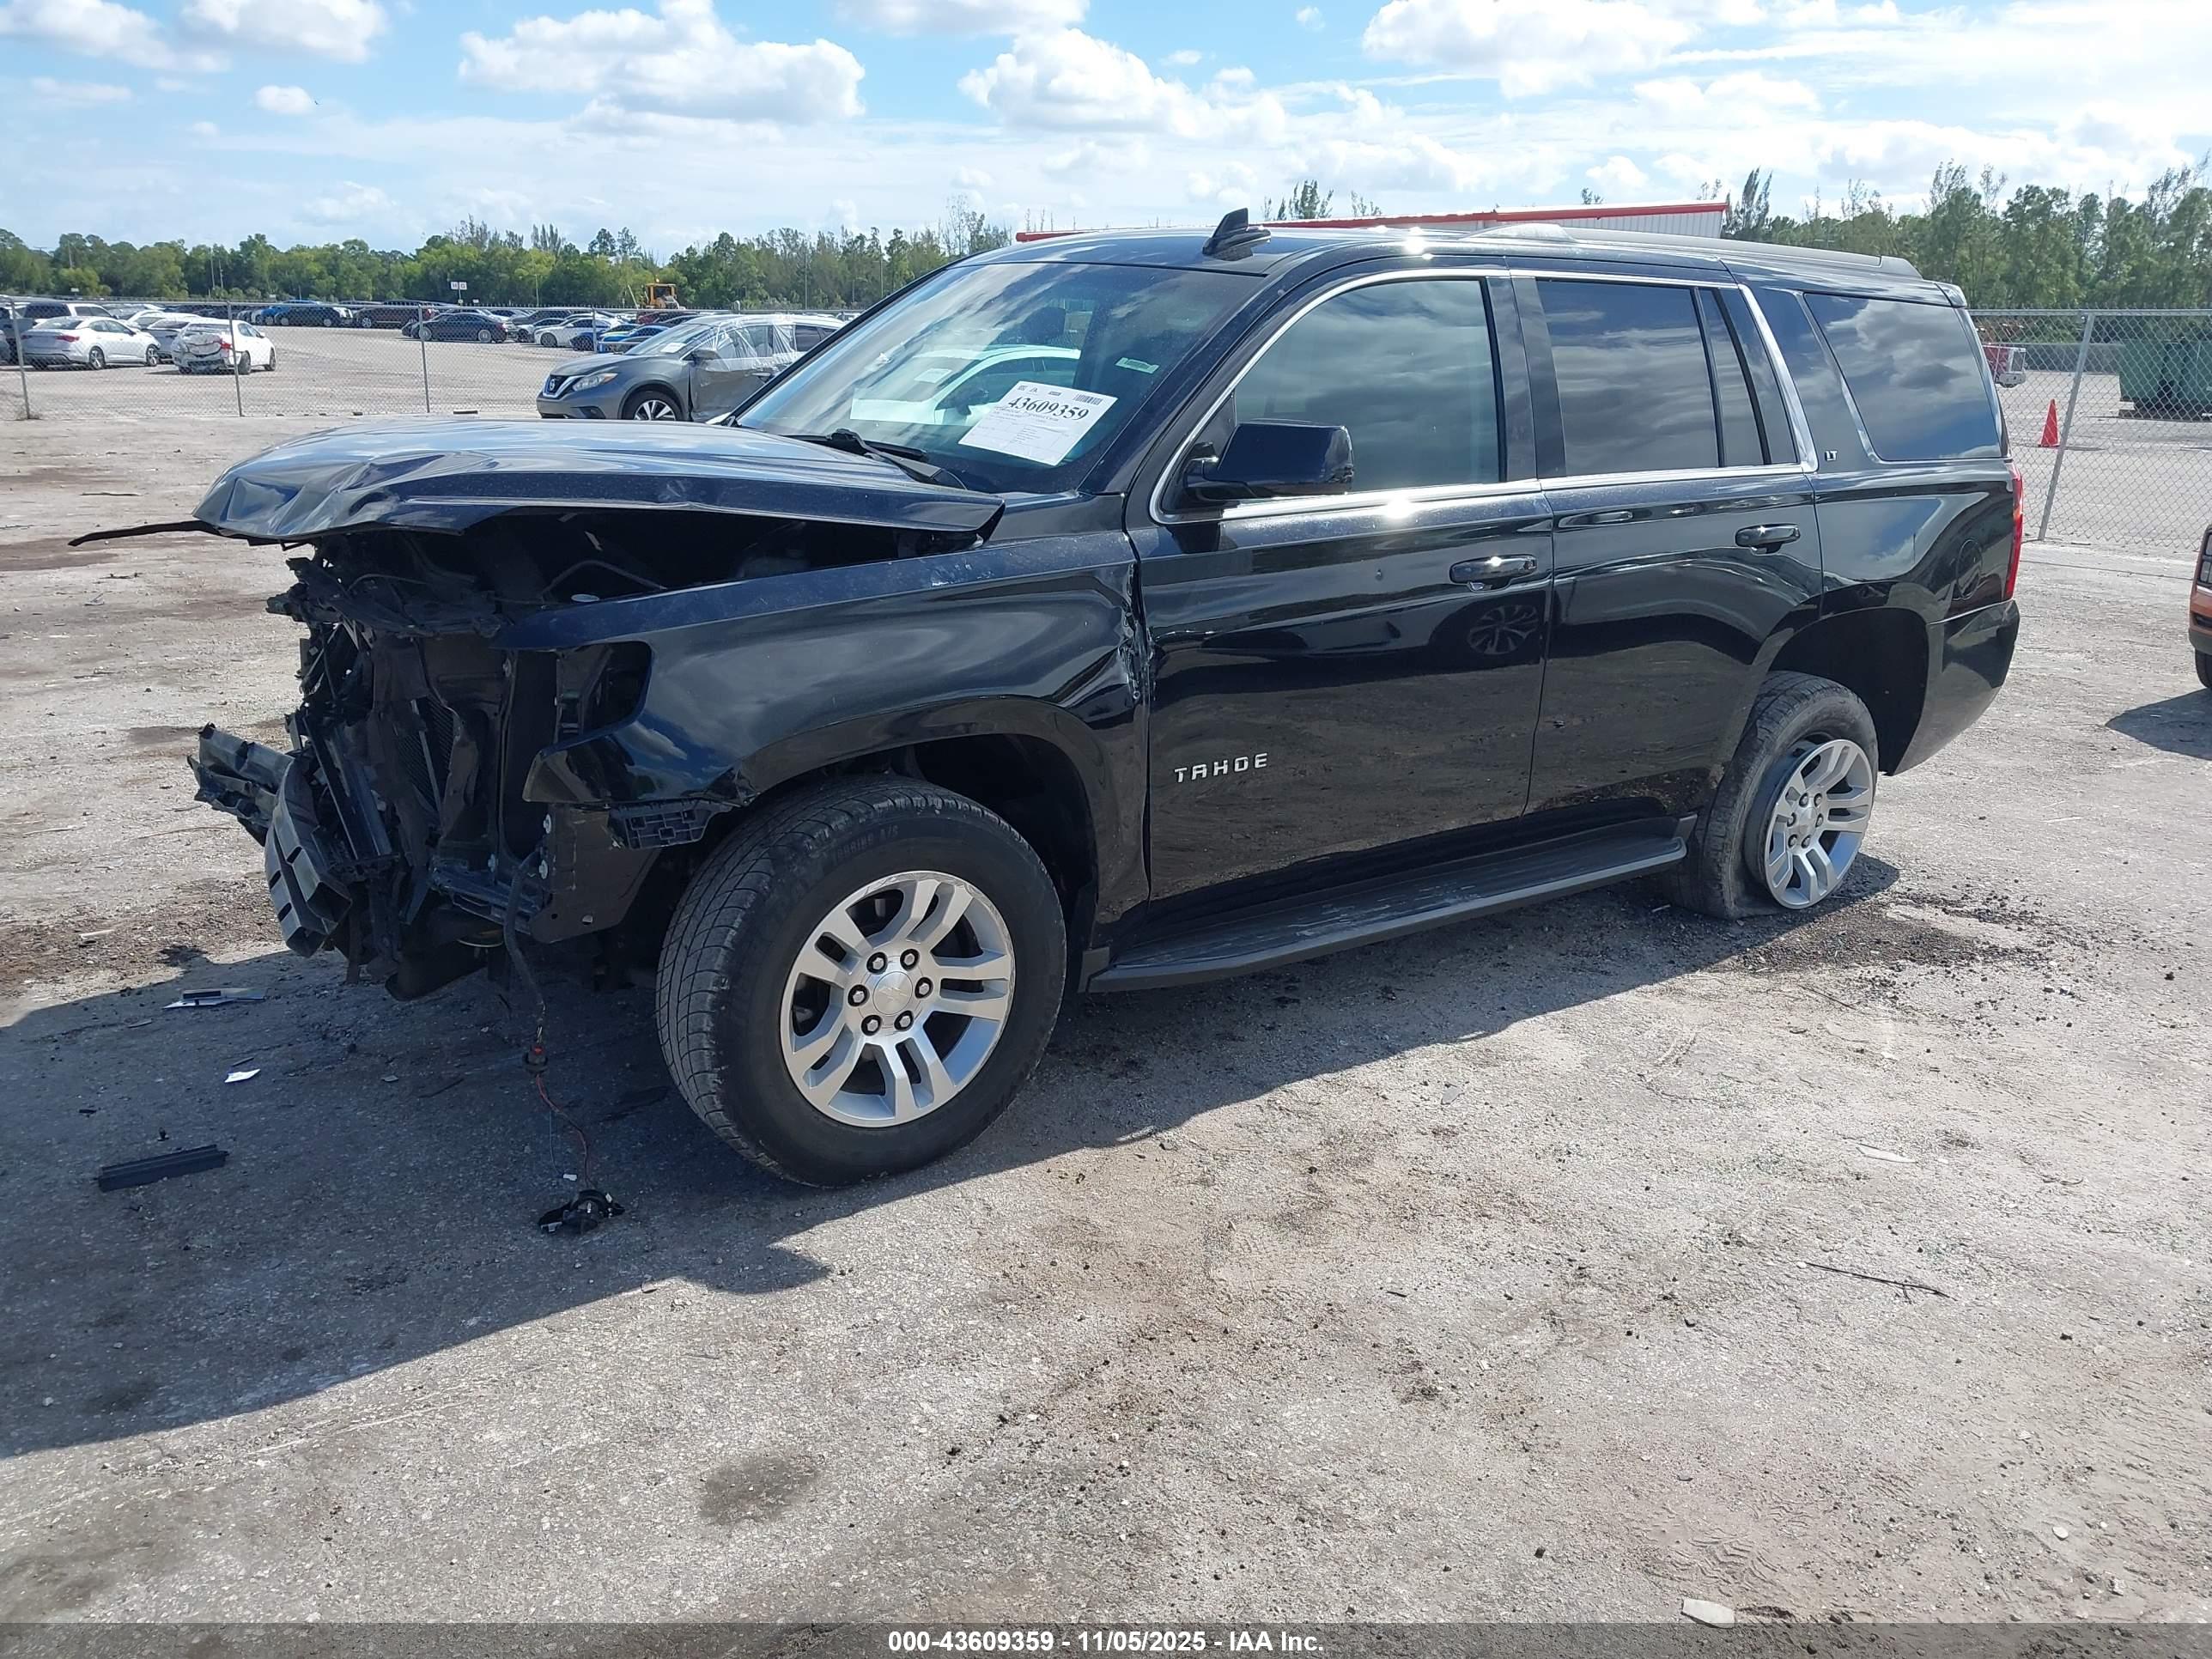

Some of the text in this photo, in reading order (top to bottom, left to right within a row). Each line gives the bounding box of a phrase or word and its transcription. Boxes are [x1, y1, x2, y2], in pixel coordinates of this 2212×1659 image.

[1007, 396, 1090, 421] 43609359
[1825, 450, 1838, 461] LT
[1174, 752, 1267, 783] TAHOE
